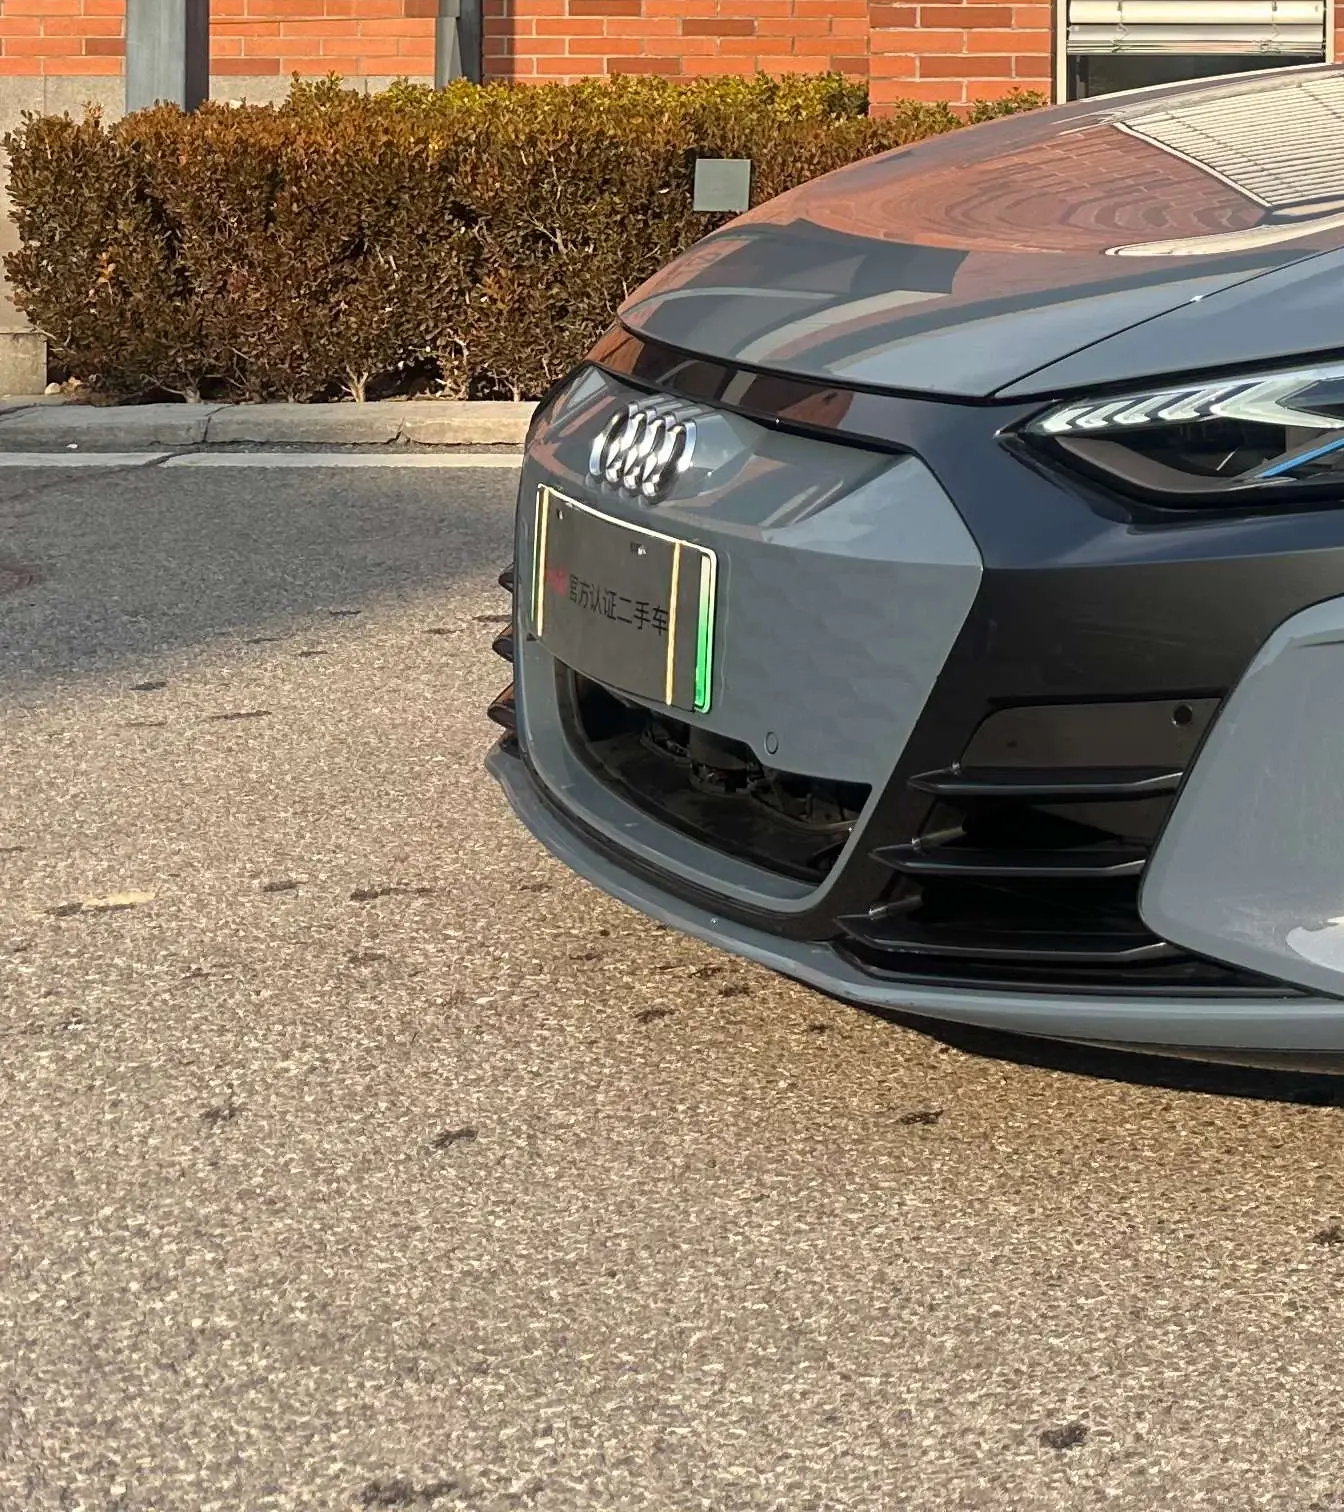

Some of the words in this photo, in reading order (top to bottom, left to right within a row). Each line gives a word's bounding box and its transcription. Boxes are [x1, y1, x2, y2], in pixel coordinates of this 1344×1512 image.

[569, 573, 669, 636] 官方认证二手车
